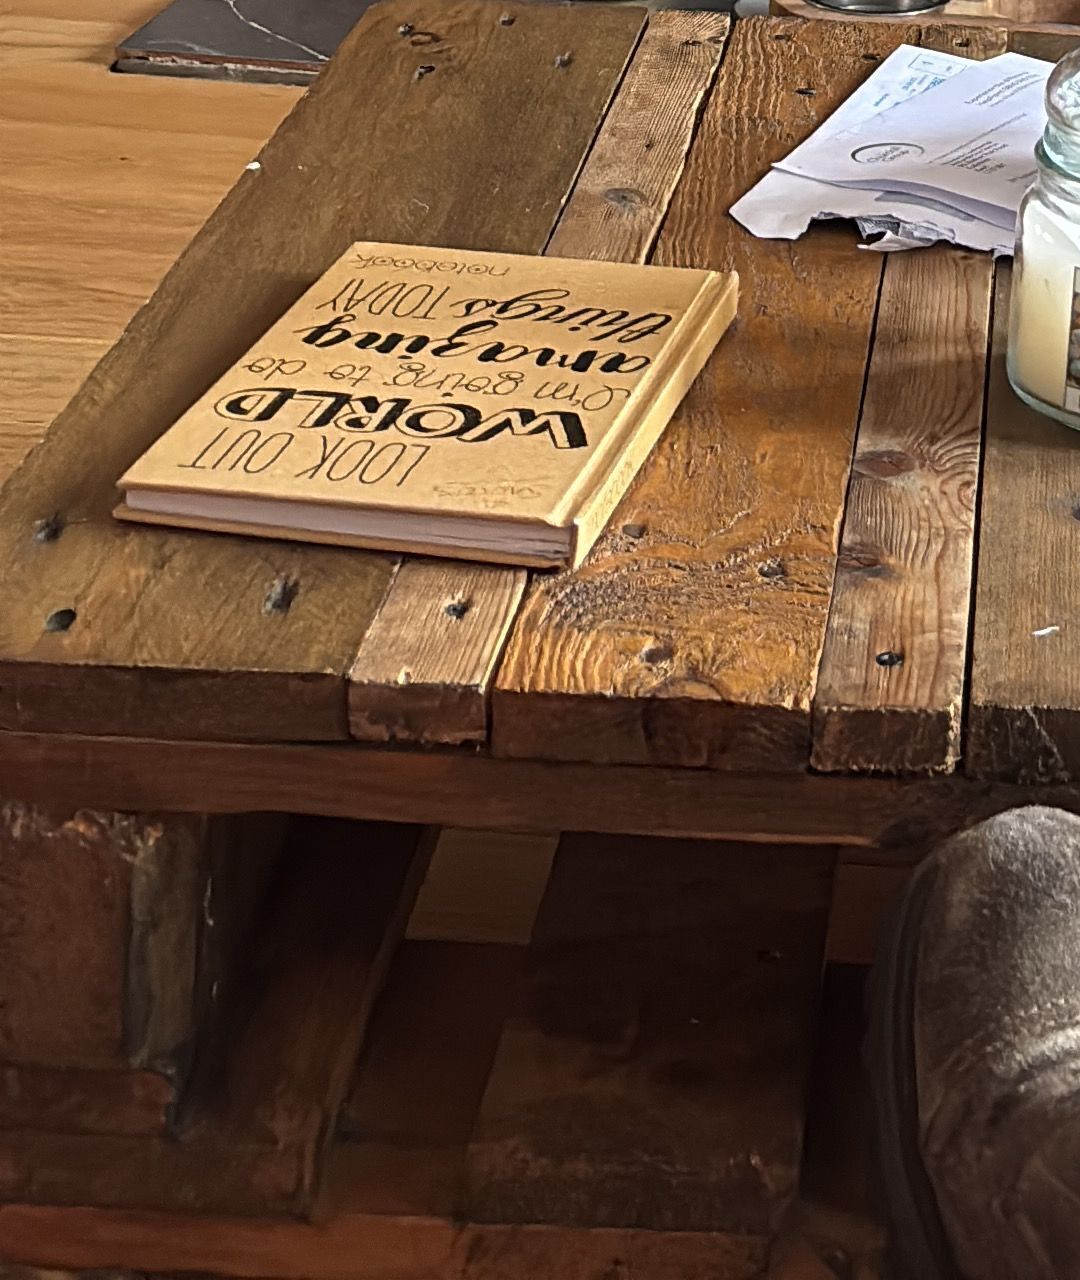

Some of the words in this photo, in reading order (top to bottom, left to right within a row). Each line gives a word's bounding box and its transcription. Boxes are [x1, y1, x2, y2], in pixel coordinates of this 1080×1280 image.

[354, 253, 511, 277] notebook
[315, 278, 451, 321] TODAY
[449, 288, 673, 343] things
[293, 314, 654, 375] amazing
[243, 356, 306, 381] do
[324, 364, 372, 388] to
[382, 361, 529, 397] going
[532, 376, 632, 413] I'm
[214, 387, 588, 449] WORLD
[177, 426, 296, 474] OUT
[296, 435, 431, 487] LOOK
